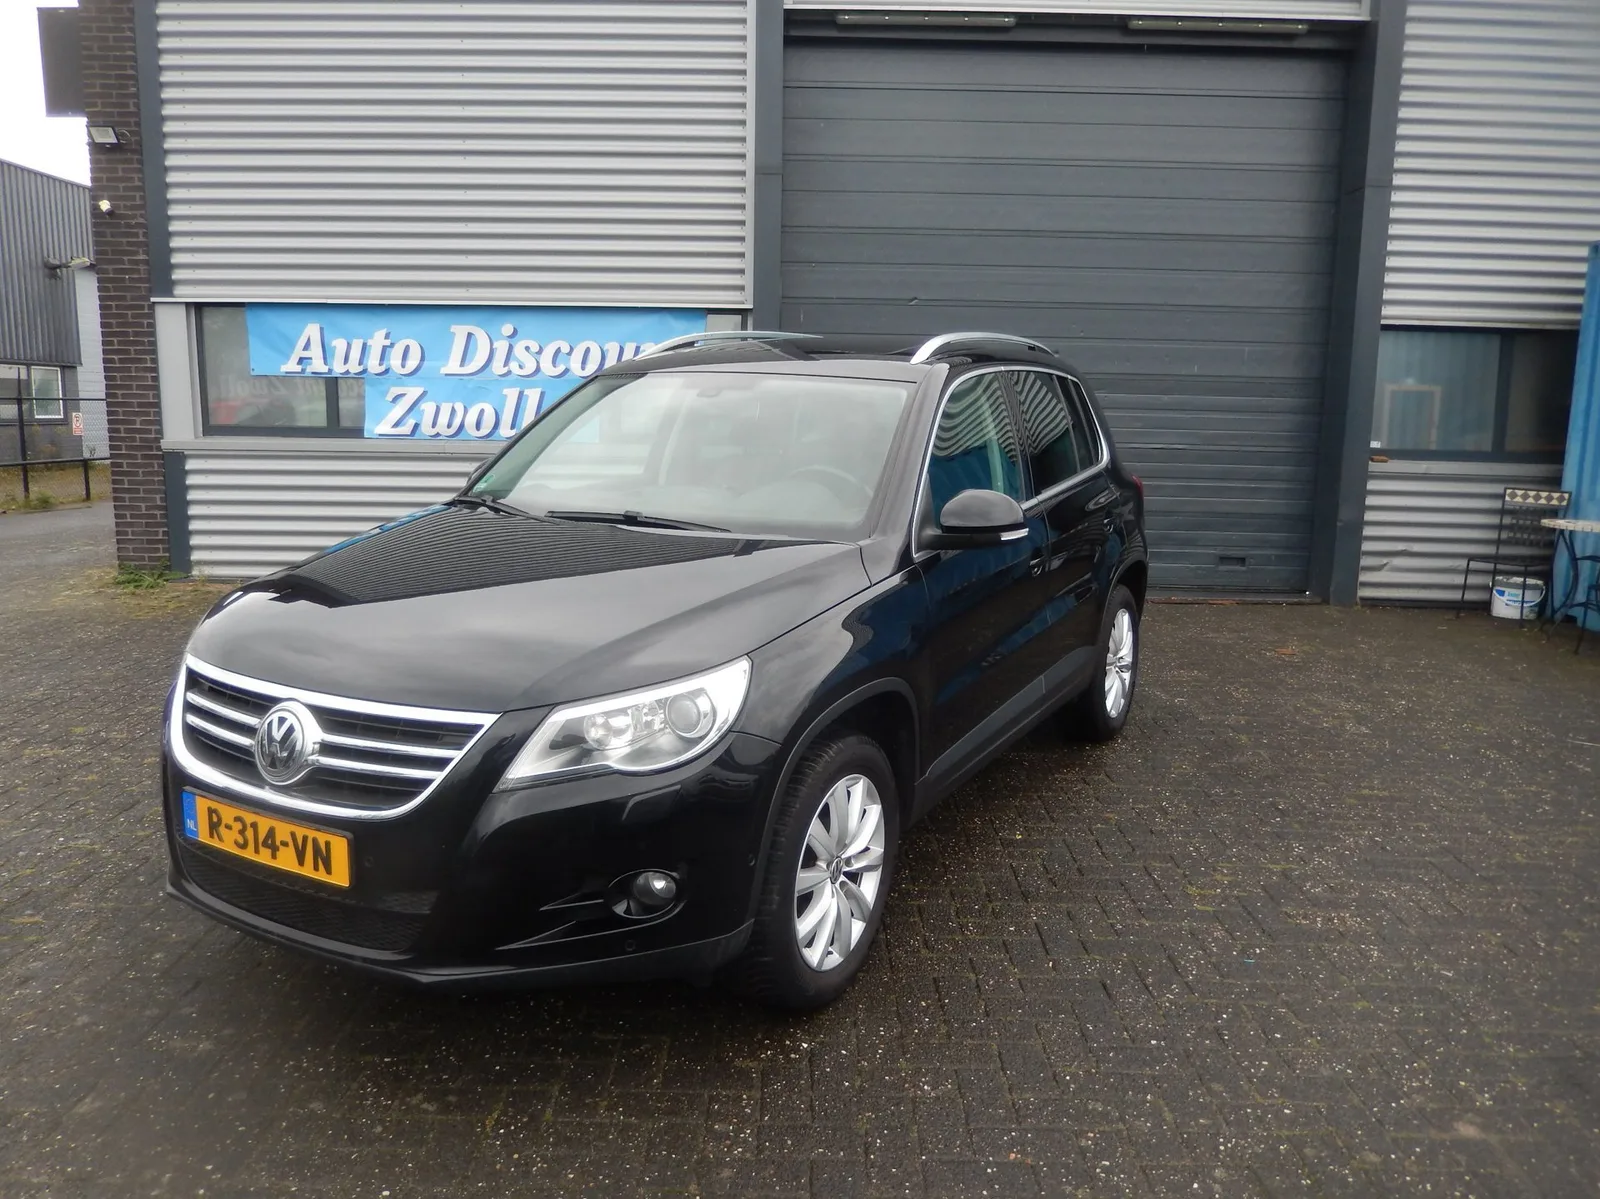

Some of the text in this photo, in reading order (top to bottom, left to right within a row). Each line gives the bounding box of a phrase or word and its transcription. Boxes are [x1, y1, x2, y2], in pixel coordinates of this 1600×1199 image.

[280, 322, 658, 377] Auto Discou
[374, 386, 543, 438] Zwoll
[187, 806, 332, 875] NL R-314-VN
